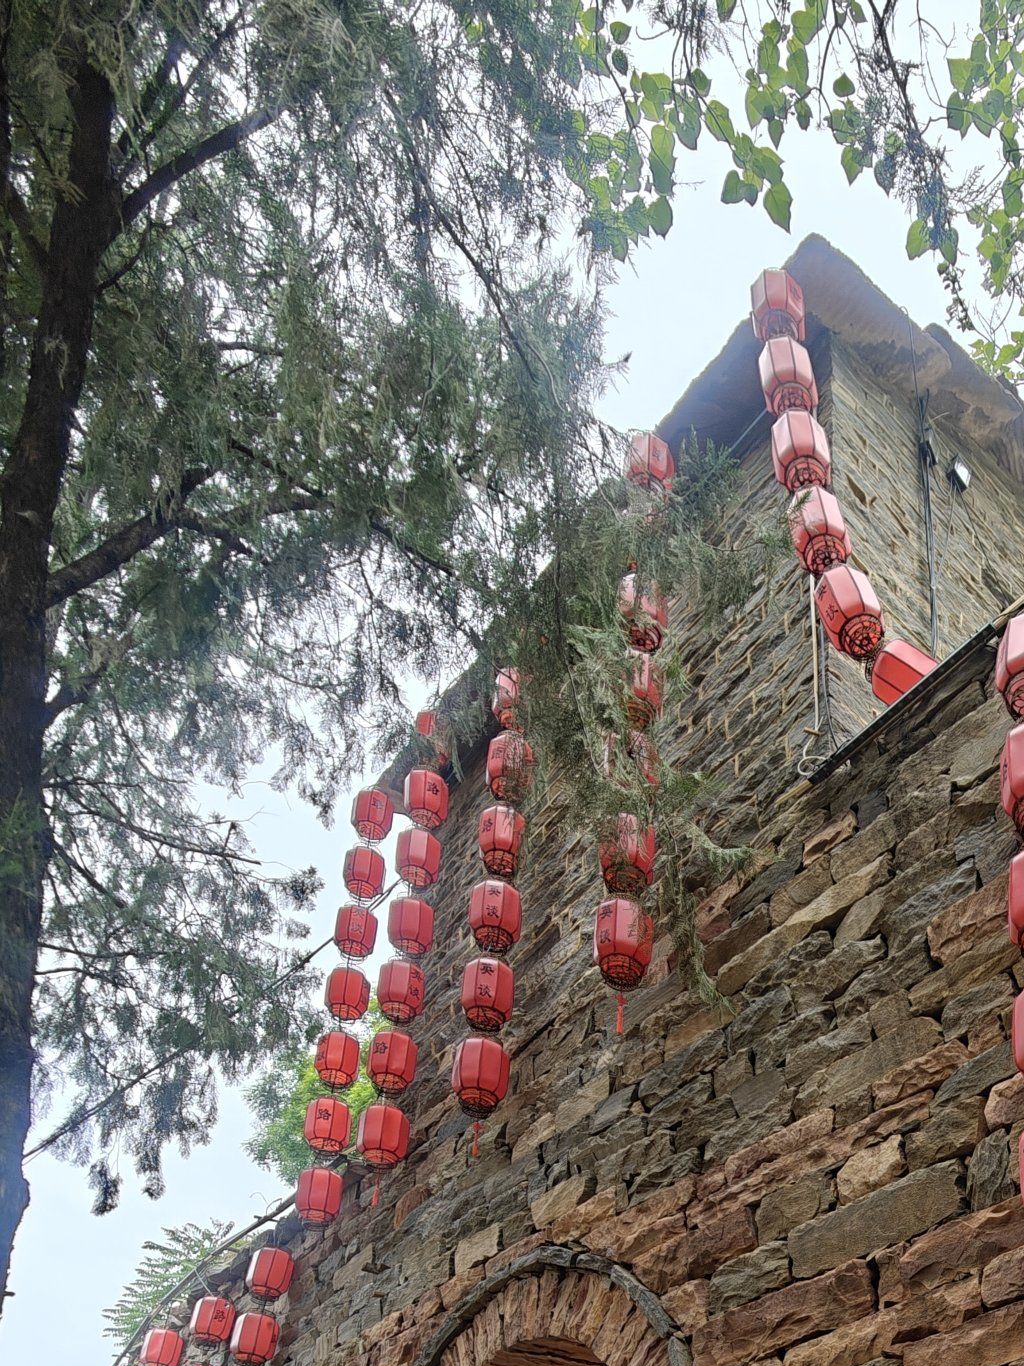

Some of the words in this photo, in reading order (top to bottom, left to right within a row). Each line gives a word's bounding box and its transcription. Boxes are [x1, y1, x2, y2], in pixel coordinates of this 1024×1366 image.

[486, 884, 501, 918] 英谈
[478, 963, 494, 998] 英谈
[375, 1041, 388, 1054] 路
[317, 1108, 331, 1121] 路
